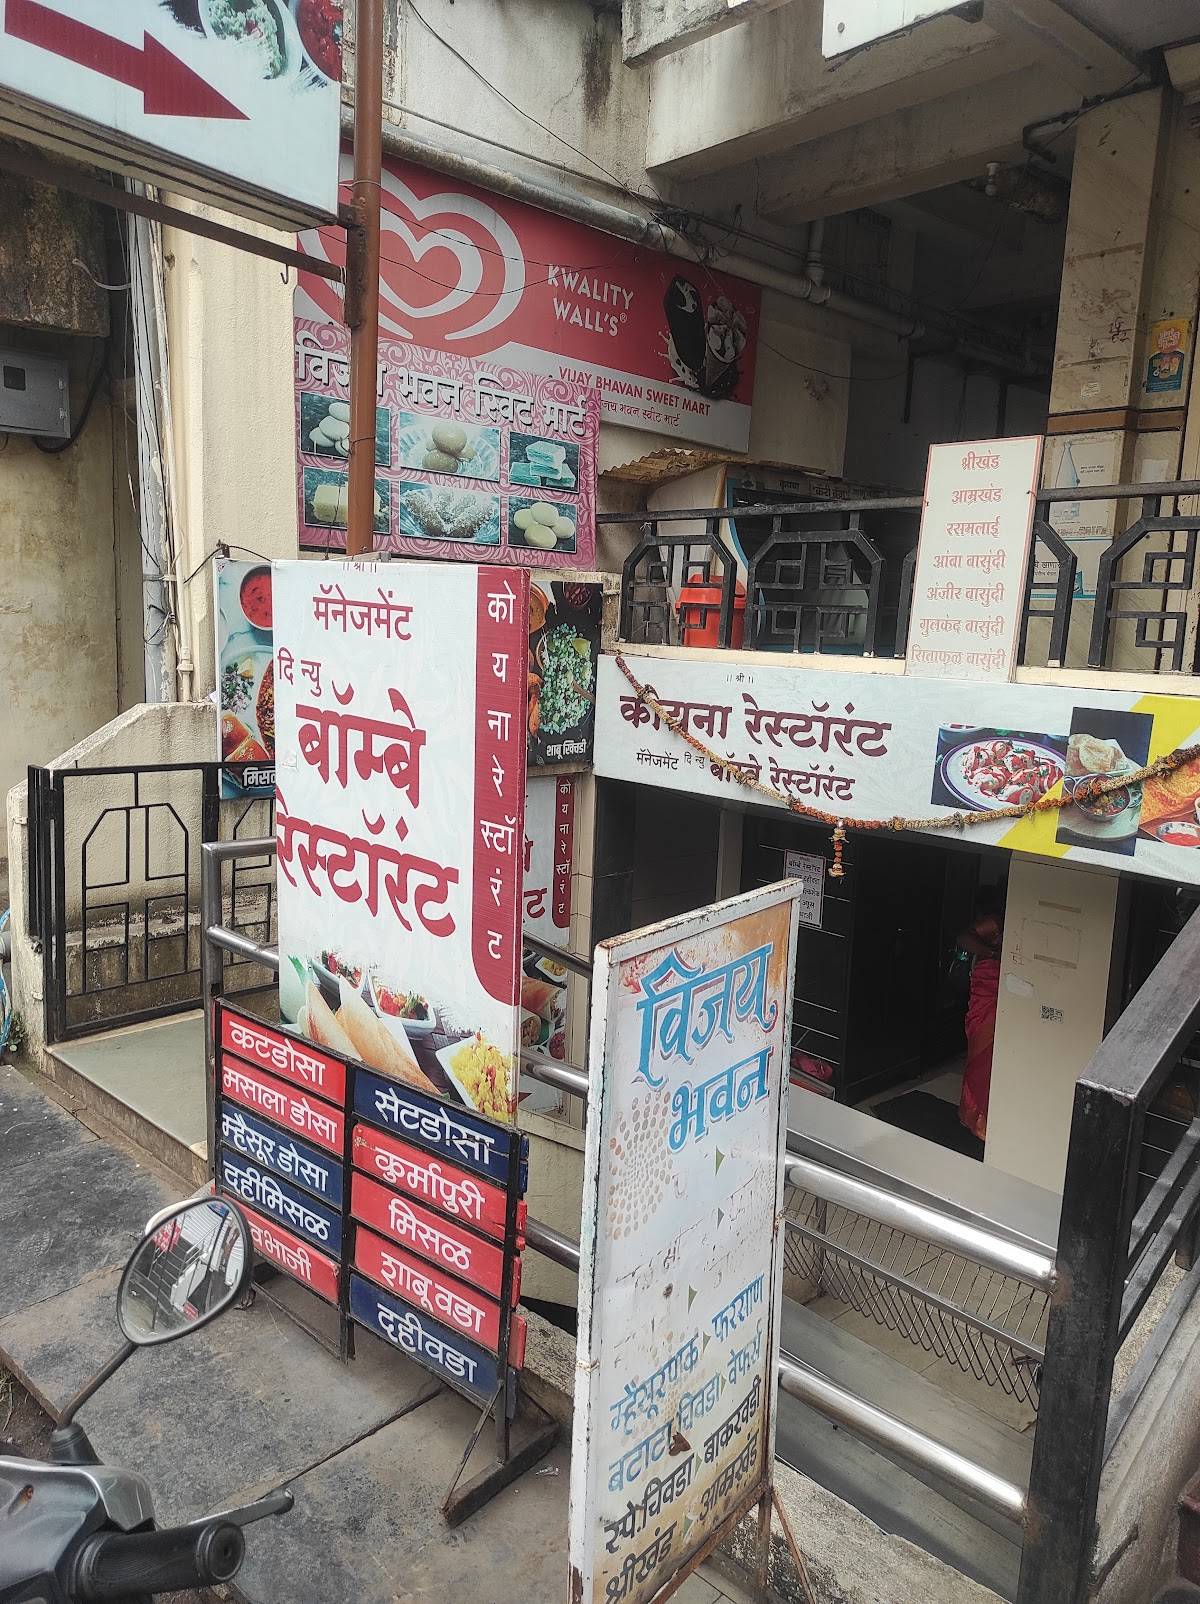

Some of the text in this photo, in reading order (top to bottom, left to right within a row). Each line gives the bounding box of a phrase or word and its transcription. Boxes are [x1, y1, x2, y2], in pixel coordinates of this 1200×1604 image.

[547, 263, 634, 310] KWALITY
[398, 366, 463, 413] भवन
[543, 395, 586, 437] मार्ट
[559, 366, 711, 417] VIJAY BHAVAN SWEET MART
[620, 403, 640, 417] भवन
[664, 412, 681, 427] मार्ट
[962, 449, 1001, 471] श्रीखंड
[946, 515, 1001, 538] रसमलाई
[313, 584, 413, 640] मॅनेजमेंट
[920, 613, 962, 637] गुलकंद
[927, 581, 962, 601] अंजीर
[278, 647, 322, 697] दि न्यु
[296, 681, 427, 809] बॉम्बे
[563, 738, 587, 756] खिचडी
[742, 693, 892, 757] रेस्टॉरंट
[636, 748, 680, 770] मॅनेजमेंट
[769, 756, 856, 801] रेस्टॉरंट
[276, 785, 460, 938] रेस्टॉरंट
[636, 942, 777, 1088] विजय
[229, 1021, 326, 1087] कटडोसा
[223, 1066, 338, 1144] मसाला डोसा
[375, 1087, 495, 1165] सेटडोसा
[668, 1045, 774, 1154] भवन
[222, 1112, 329, 1192] म्हैसूर डोसा
[375, 1146, 486, 1220] कुर्मापुरी
[388, 1198, 472, 1270] मिसळ
[381, 1252, 485, 1333] शाबू वडा
[377, 1303, 478, 1383] दहीवडा
[703, 1374, 762, 1464] बाकरवडी
[604, 1519, 679, 1604] श्रीखंड
